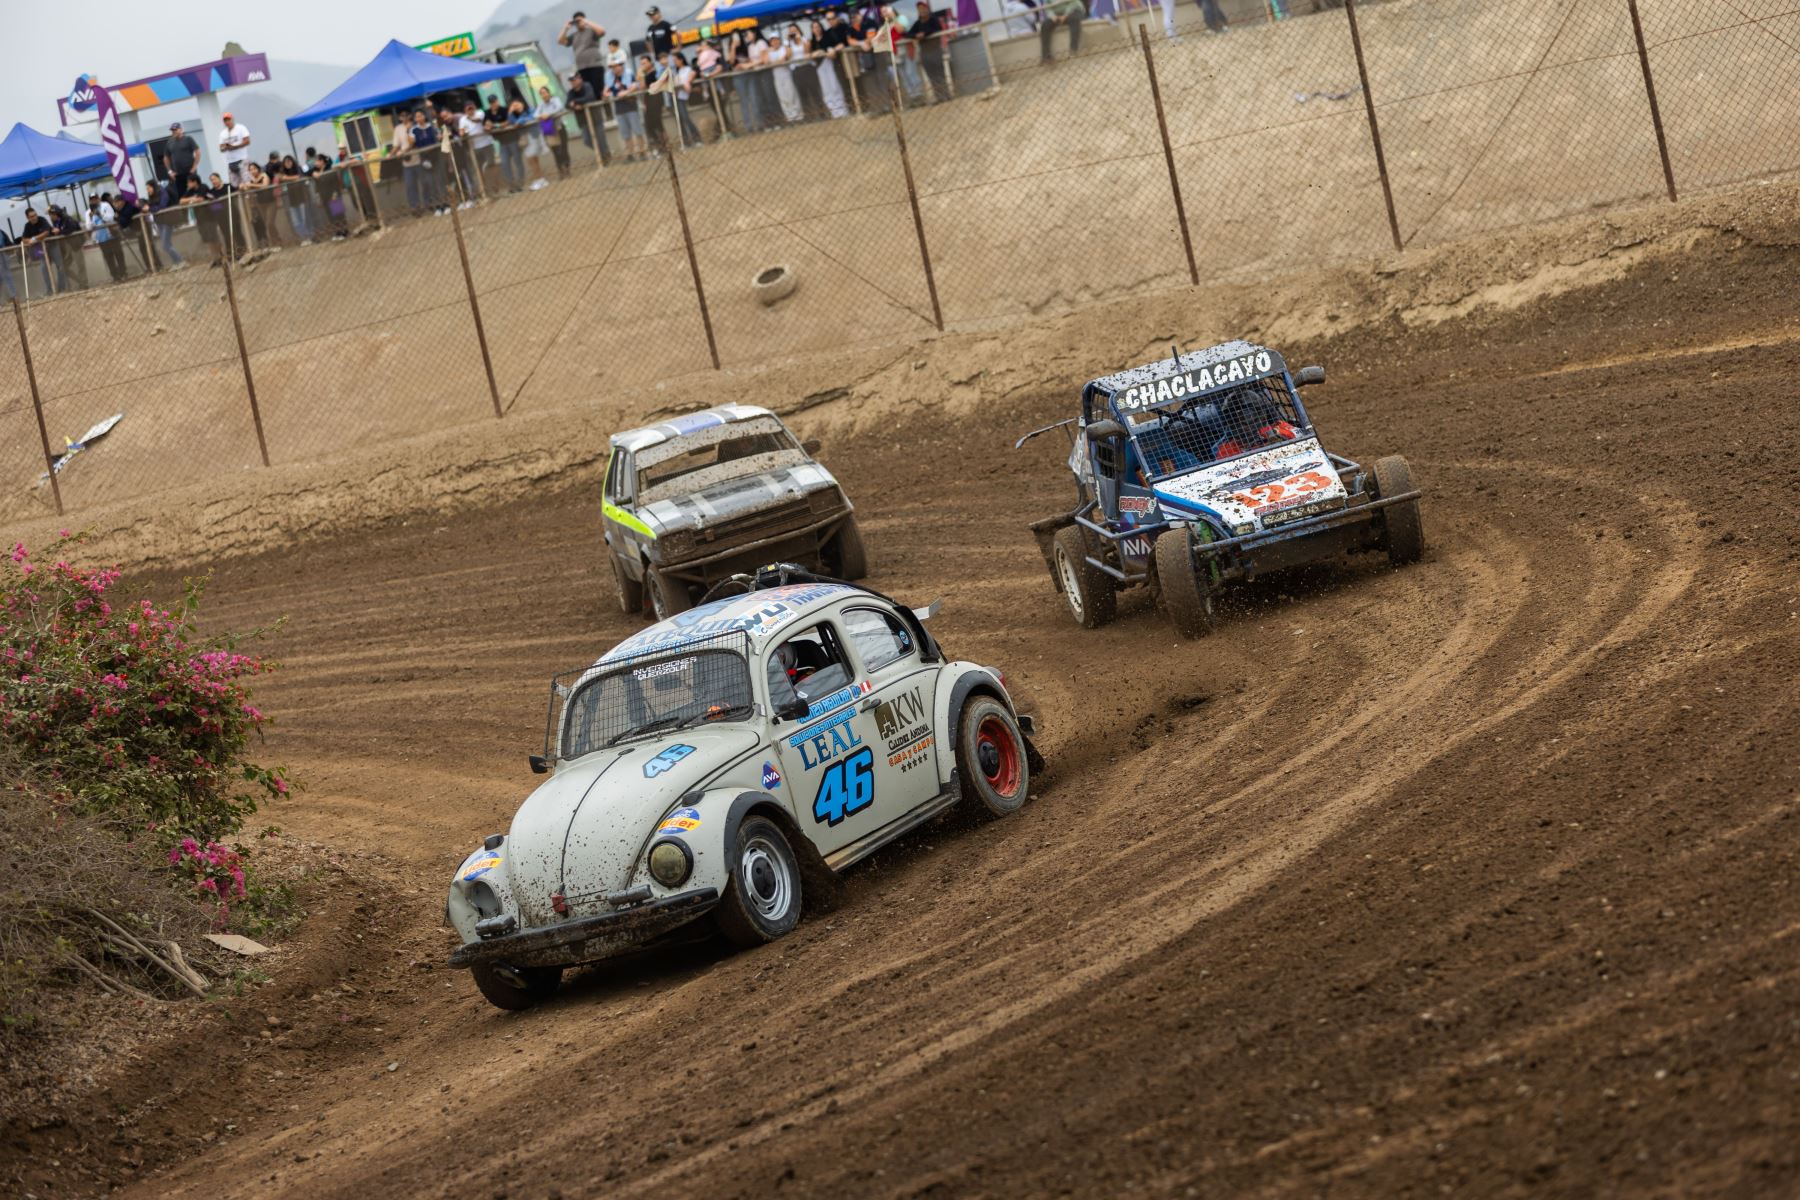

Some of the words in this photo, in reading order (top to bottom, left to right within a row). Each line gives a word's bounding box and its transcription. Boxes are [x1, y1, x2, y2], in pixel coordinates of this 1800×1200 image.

[1125, 351, 1272, 409] CHACLACAYO
[1231, 471, 1333, 508] 123
[642, 744, 697, 778] 46
[796, 720, 862, 771] LEAL
[763, 771, 780, 785] AVA
[812, 745, 875, 828] 46
